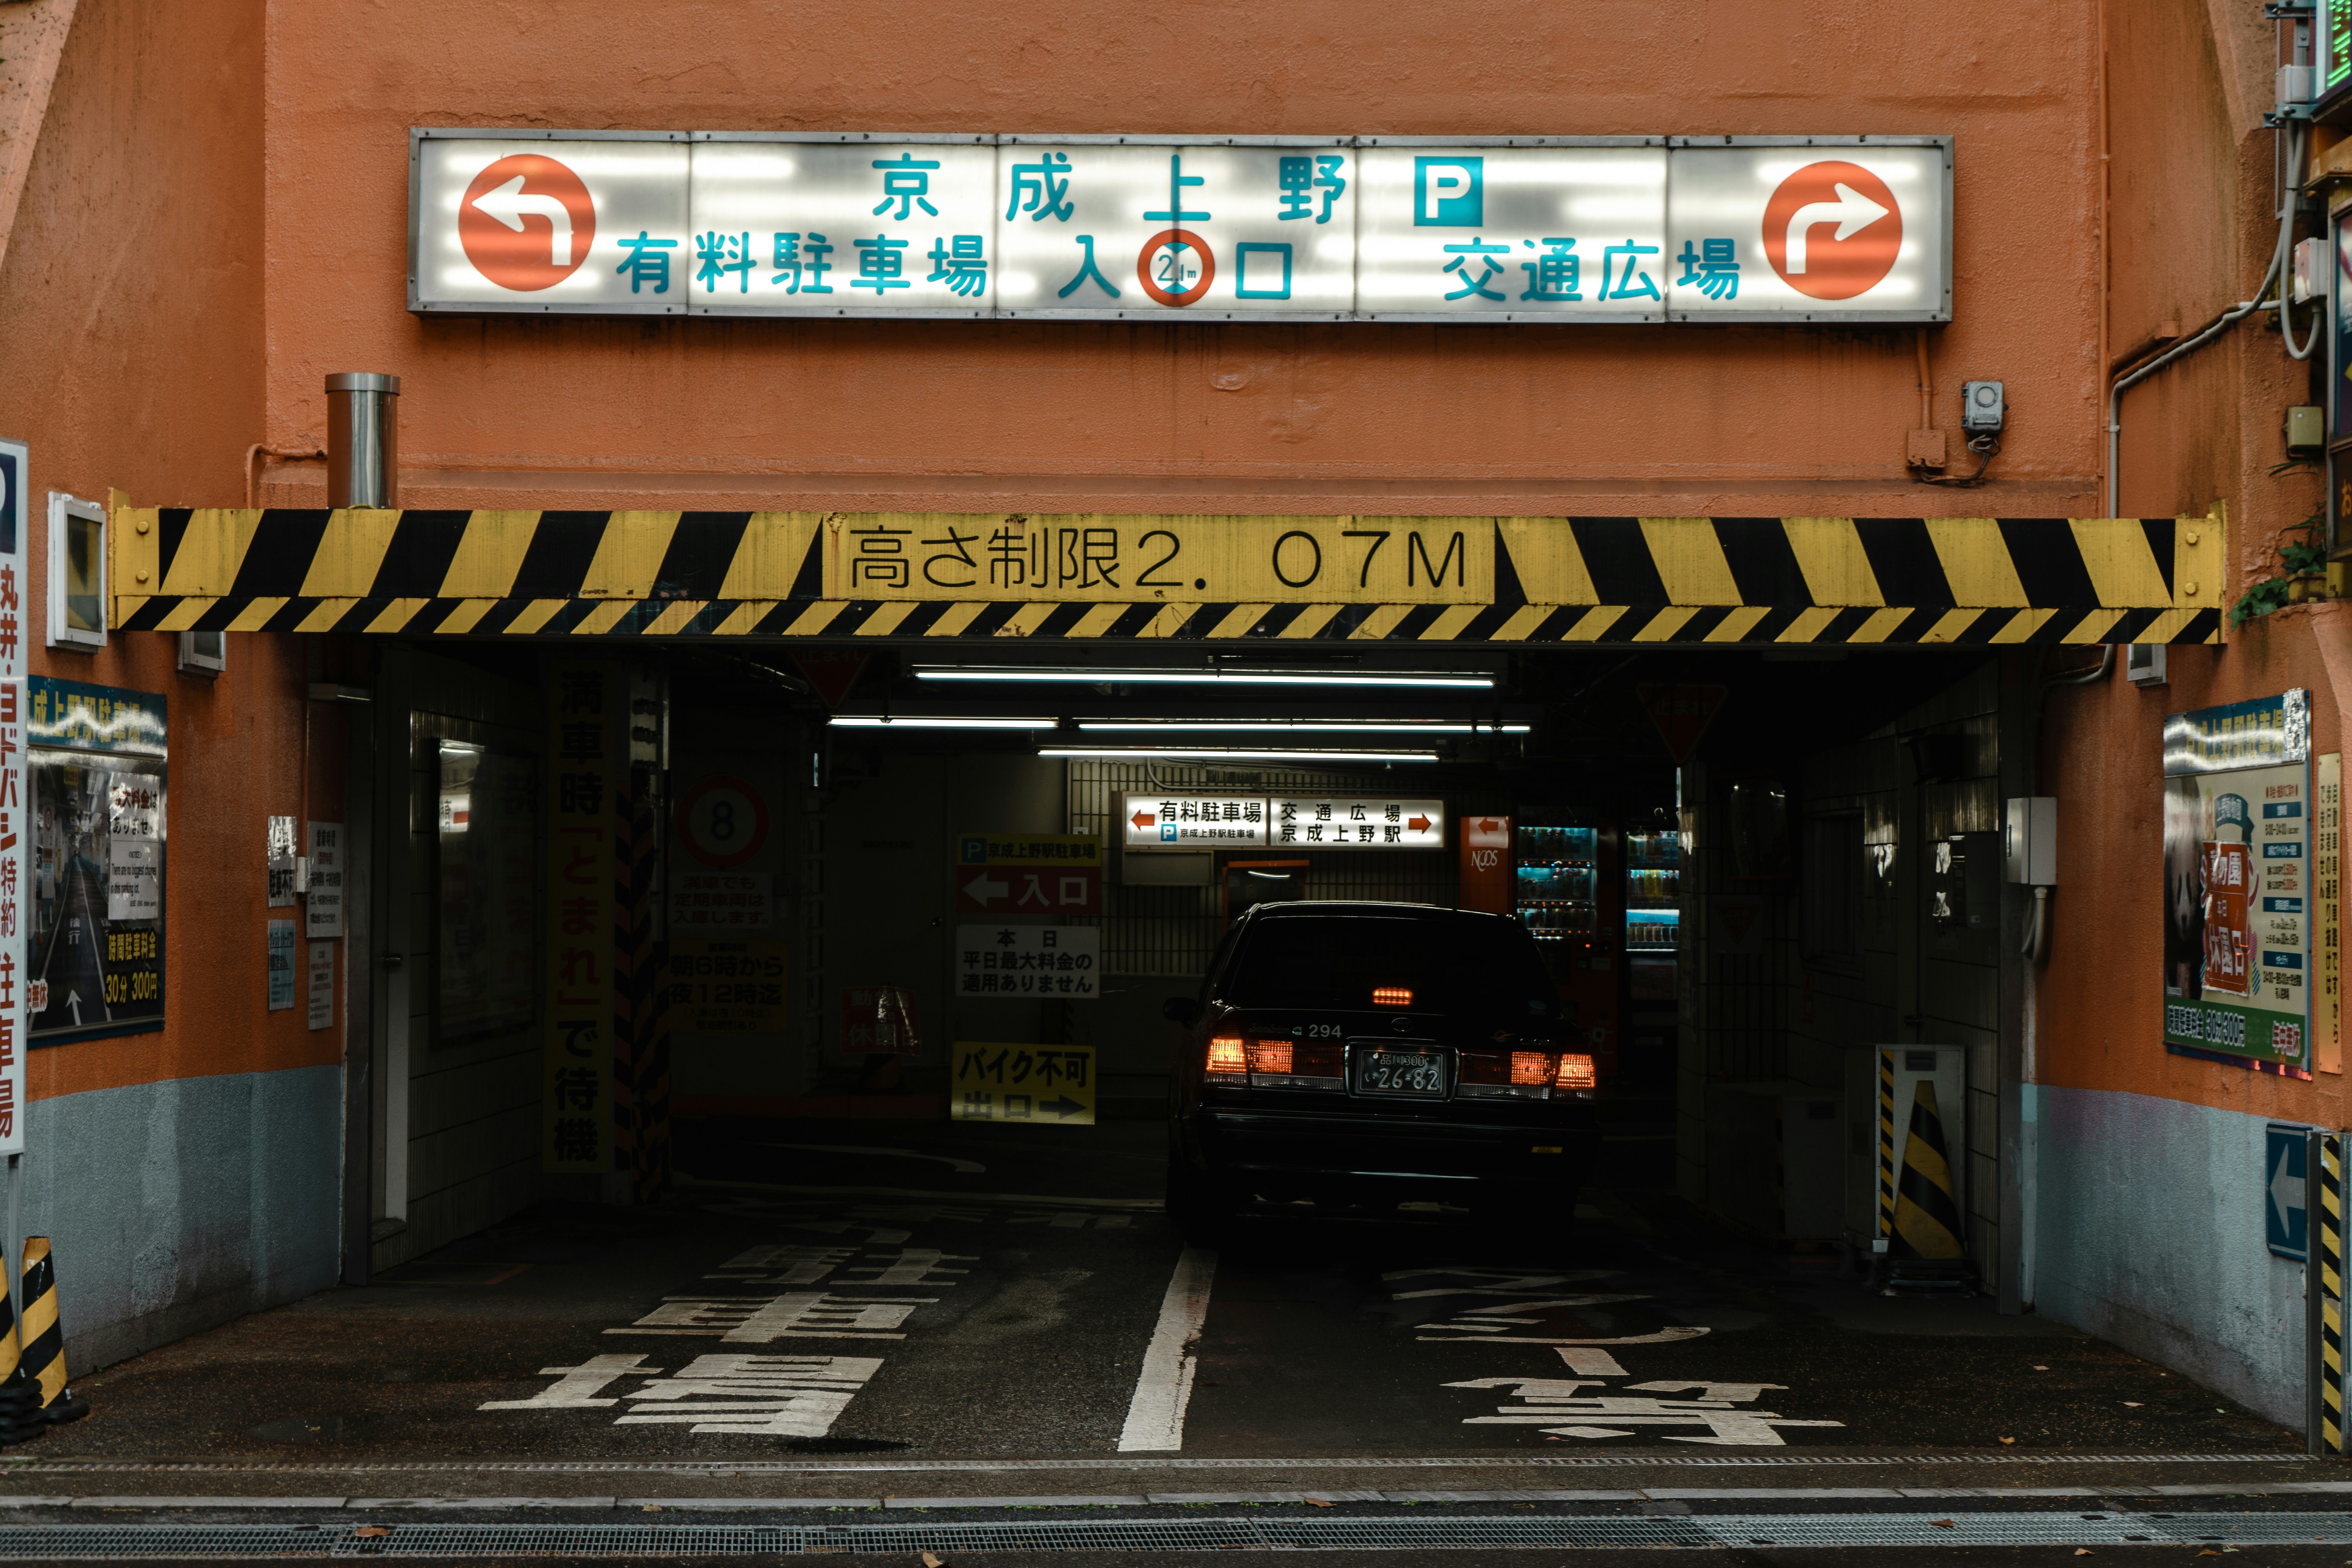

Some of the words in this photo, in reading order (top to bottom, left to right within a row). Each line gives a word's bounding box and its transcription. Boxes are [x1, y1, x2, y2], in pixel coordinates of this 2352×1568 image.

[872, 152, 1345, 225] 京成上野
[1425, 165, 1471, 218] P
[616, 231, 988, 297] 有料駐車場
[1443, 237, 1740, 301] 交通広場
[711, 800, 735, 841] 8
[1159, 801, 1261, 823] 有料駐車場
[1280, 803, 1401, 822] 交通広場
[1180, 829, 1255, 840] 京成上野駅駐車場
[1280, 824, 1401, 844] 京成上野駅
[988, 843, 1096, 859] 京成上野駅駐車場
[684, 876, 756, 890] 満車でも
[1016, 874, 1088, 907] 入口
[675, 893, 764, 907] 定期車両は
[554, 670, 605, 1162] 満車時「とまれ」で待機
[673, 910, 769, 925] 入庫します。
[708, 943, 748, 953] 営業時間
[670, 955, 784, 977] 朝6時から
[963, 951, 1092, 971] 平日最大料金の
[670, 983, 782, 1005] 夜12時迄
[963, 974, 1093, 993] 適用ありません
[695, 1020, 757, 1031] 宿泊割引あり
[1308, 1024, 1342, 1038] 294
[958, 1047, 1090, 1088] バイク不可
[1377, 1067, 1438, 1090] 26-82
[962, 1090, 1032, 1119] 出口
[475, 1244, 980, 1438] 駐車場
